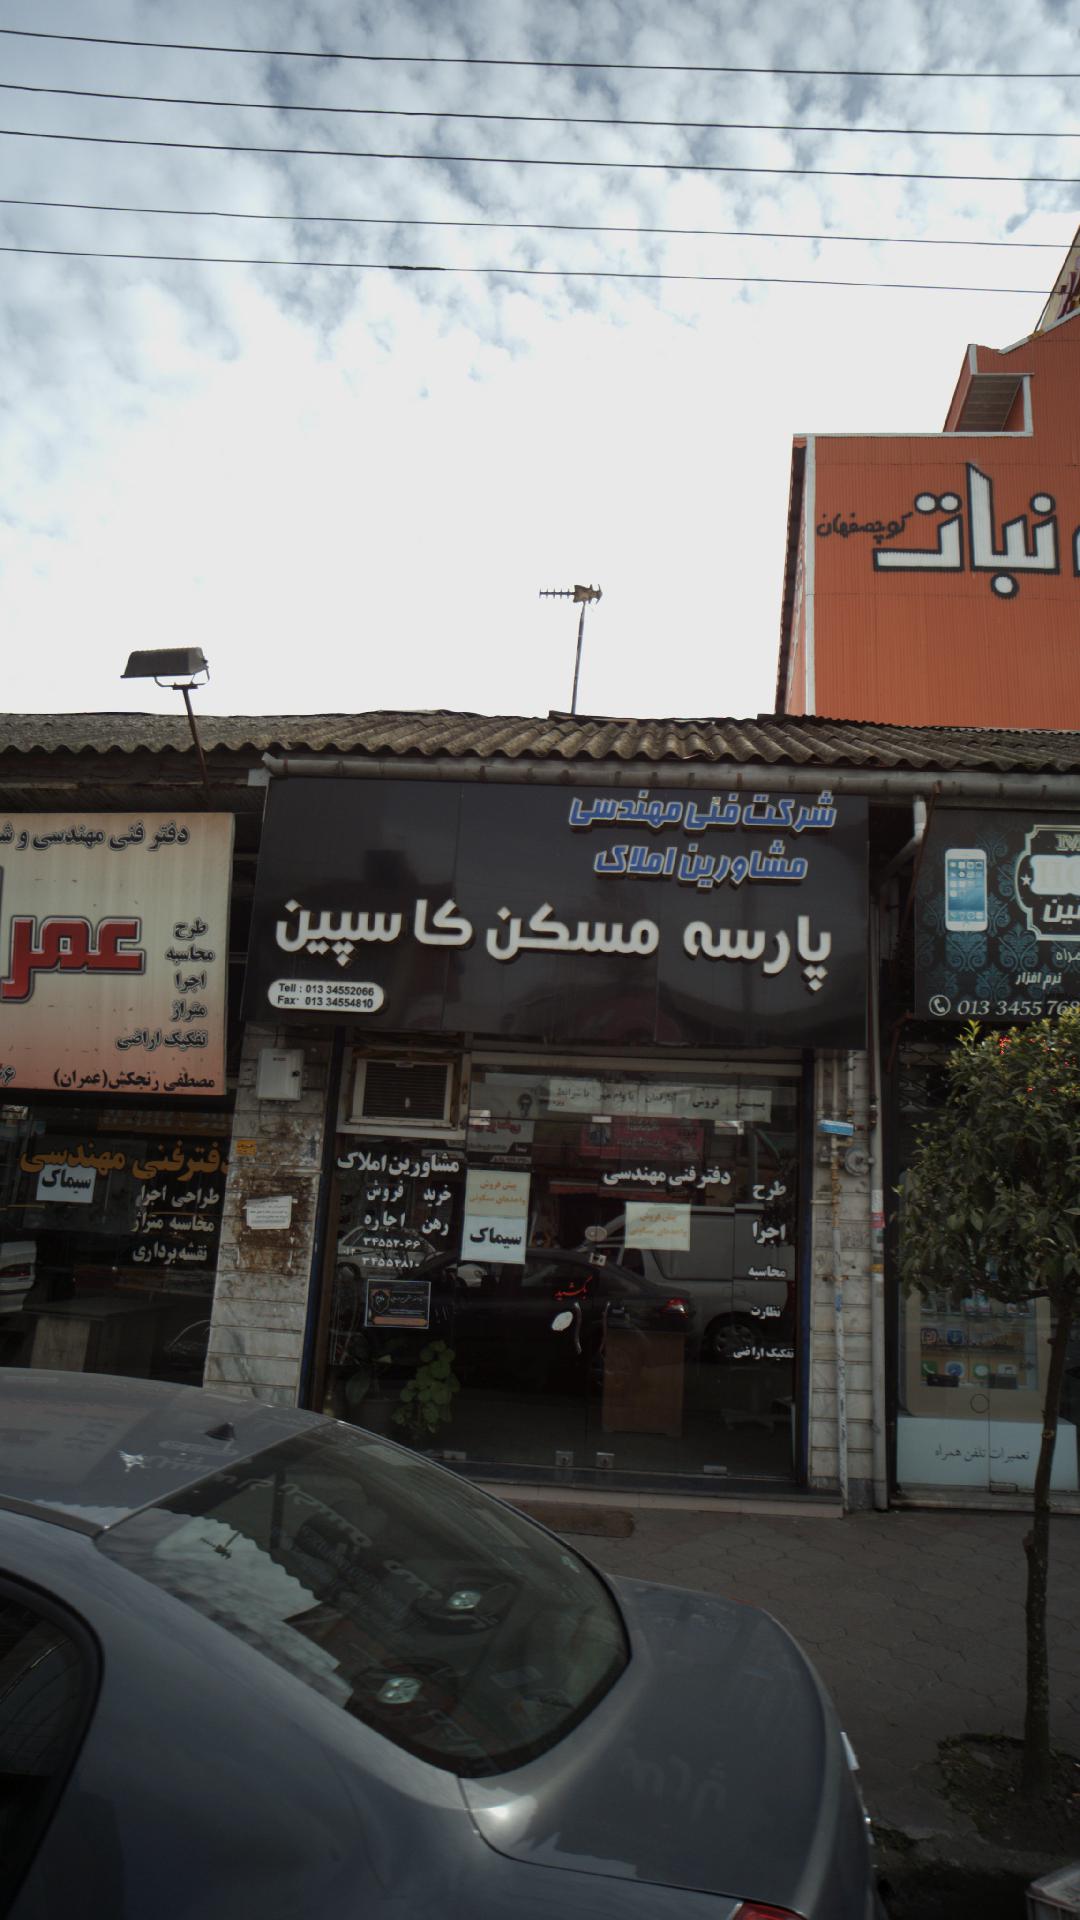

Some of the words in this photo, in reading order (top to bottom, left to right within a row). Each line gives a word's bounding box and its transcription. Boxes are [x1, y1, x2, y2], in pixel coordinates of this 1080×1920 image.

[816, 512, 913, 544] کوچصفهان
[873, 462, 1060, 600] نبات
[568, 789, 683, 829] مهندسی
[683, 793, 742, 830] فنی
[742, 790, 838, 832] شرکت
[32, 824, 105, 850] مهندسی
[109, 820, 143, 850] فنی
[147, 821, 188, 850] دفتر
[594, 845, 677, 875] املاک
[678, 839, 809, 888] مشاورین
[174, 917, 207, 940] طرح
[486, 902, 660, 961] مسکن
[1, 914, 146, 1003] عمر
[165, 945, 215, 965] محاسبه
[683, 915, 832, 992] پارسه
[174, 971, 206, 993] اجرا
[1015, 971, 1041, 986] افزار
[1042, 971, 1062, 990] نرم
[305, 984, 323, 994] 013
[326, 985, 375, 997] 34552066
[170, 1000, 207, 1022] متراژ
[305, 996, 323, 1006] 013
[326, 998, 374, 1008] 34554810
[957, 1000, 990, 1016] 013
[995, 1000, 1042, 1016] 3455
[116, 1028, 161, 1051] اراضی
[163, 1028, 208, 1050] تفکیک
[163, 1067, 215, 1092] مصطفی
[19, 1139, 126, 1176] مهندسی
[131, 1139, 185, 1180] فنی
[337, 1152, 387, 1172] املاک
[389, 1152, 459, 1177] مشاورین
[42, 1168, 91, 1193] سیماک
[603, 1167, 667, 1185] مهندسی
[668, 1166, 697, 1185] فنی
[697, 1166, 731, 1189] دفتر
[141, 1184, 168, 1206] اجرا
[171, 1186, 220, 1209] طراحی
[366, 1180, 404, 1202] فروش
[423, 1184, 452, 1207] خرید
[752, 1180, 787, 1200] طرح
[130, 1211, 164, 1234] متراژ
[169, 1214, 215, 1235] محاسبه
[364, 1210, 406, 1232] اجاره
[422, 1218, 449, 1236] رهن
[470, 1227, 521, 1248] سیماک
[752, 1221, 786, 1244] اجرا
[748, 1265, 787, 1280] محاسبه
[751, 1305, 781, 1319] نظارت
[733, 1346, 764, 1360] اراضی
[766, 1347, 795, 1361] تفکیک
[935, 1442, 961, 1461] همراه
[964, 1447, 985, 1462] تلفن
[989, 1447, 1030, 1463] تعمیرات
